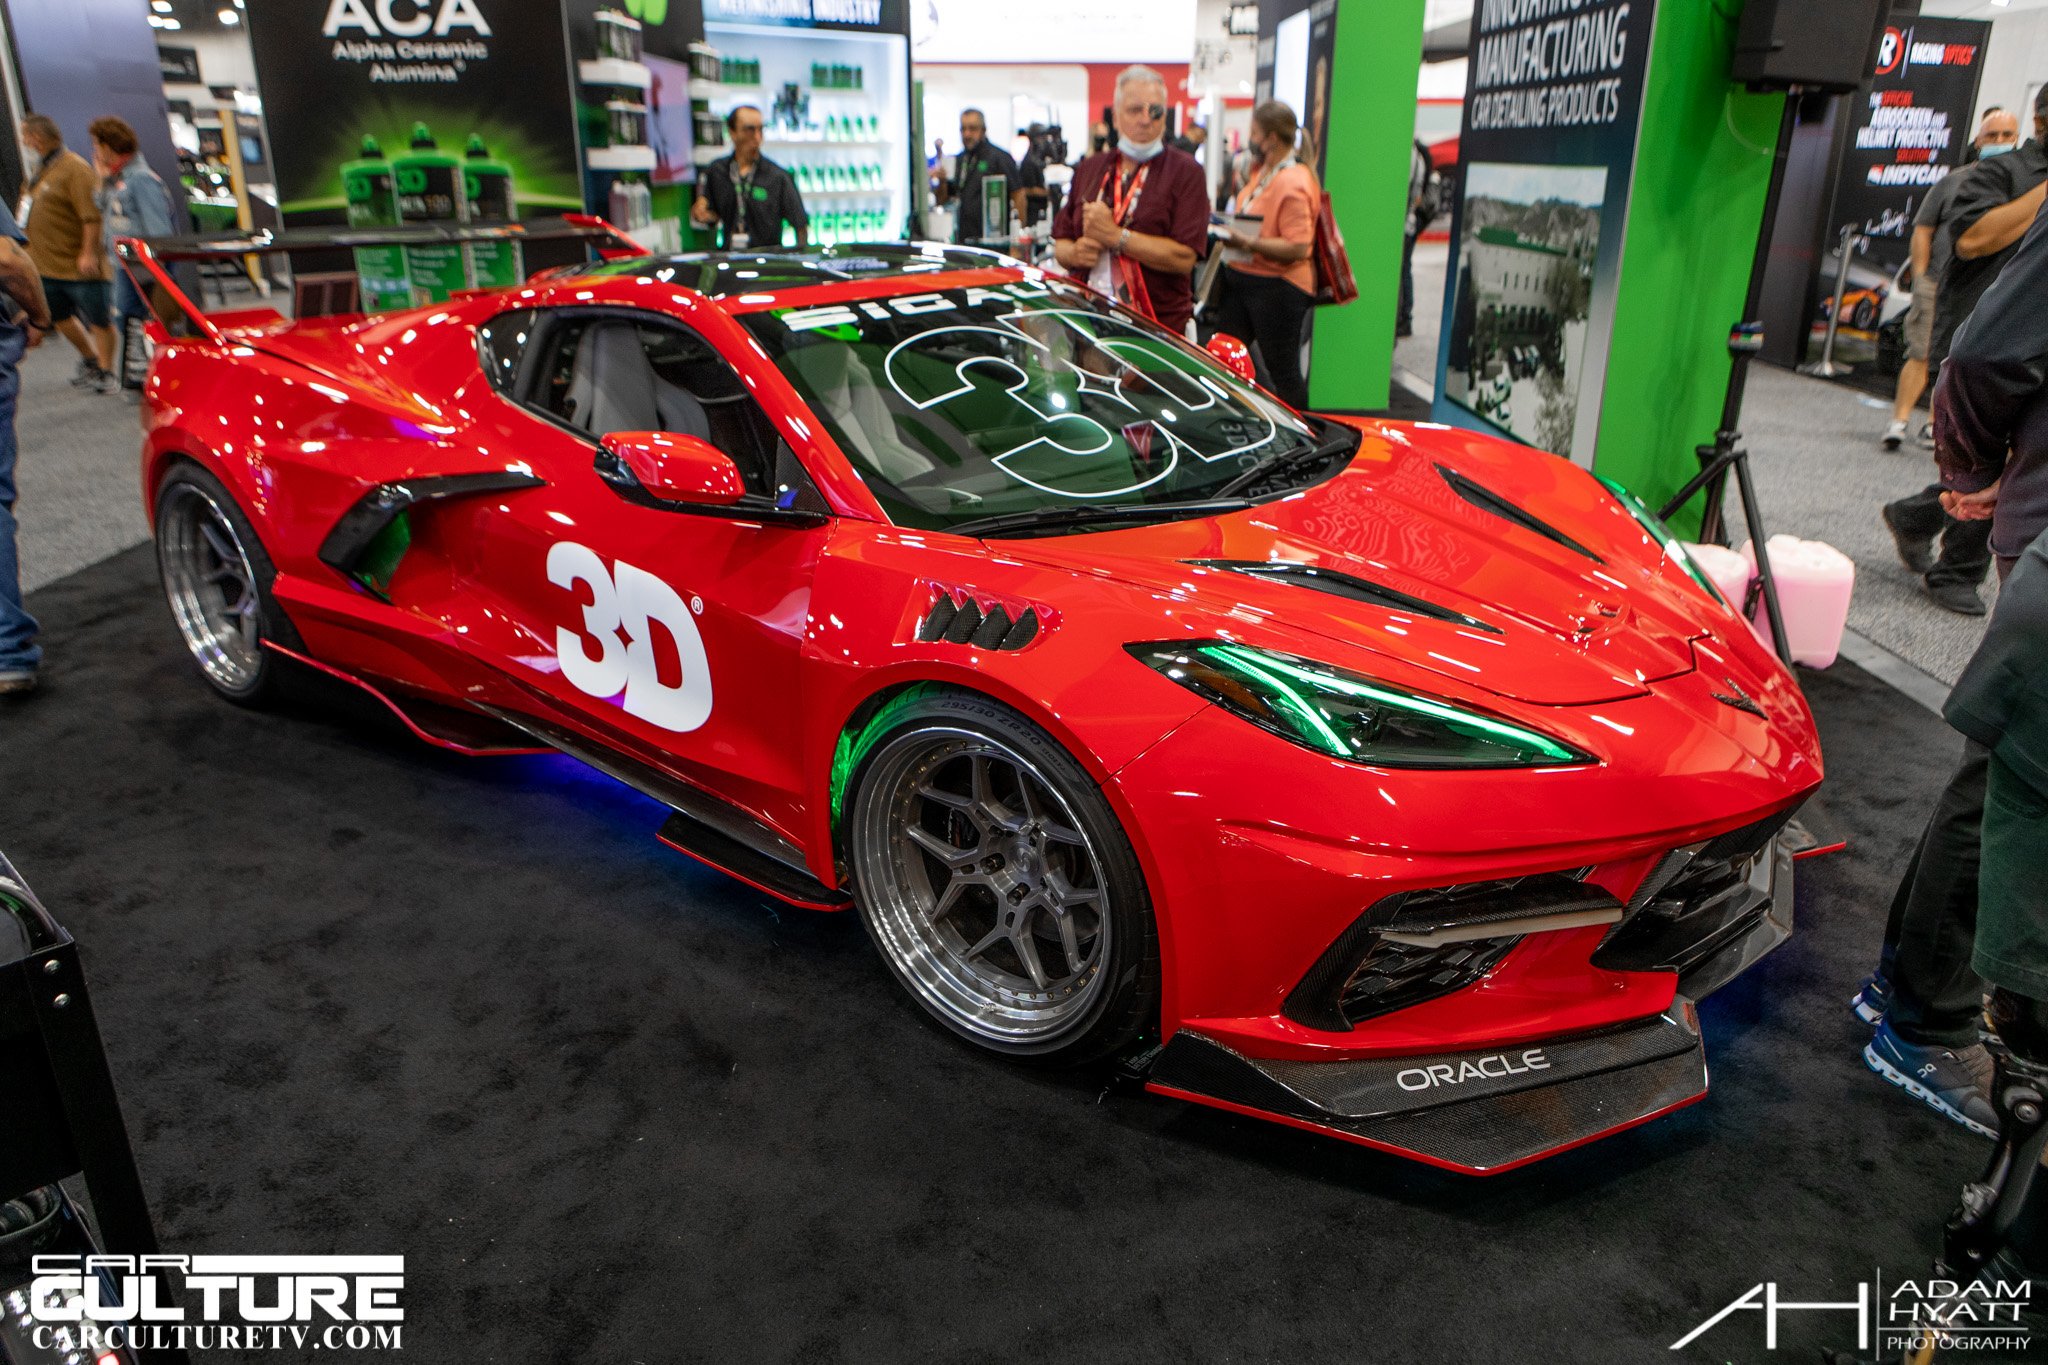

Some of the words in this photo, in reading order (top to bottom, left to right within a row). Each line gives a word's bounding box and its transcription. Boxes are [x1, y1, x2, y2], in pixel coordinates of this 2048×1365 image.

[322, 0, 493, 37] ACA
[332, 40, 396, 63] Alpha
[396, 39, 489, 60] Ceramic
[1475, 3, 1630, 89] MANUFACTURING
[369, 62, 459, 83] Alumina
[1471, 91, 1491, 130] CAR
[1489, 85, 1549, 129] DETAILING
[1547, 76, 1621, 127] PRODUCTS
[546, 541, 713, 733] 3D
[941, 701, 995, 718] 295/30
[998, 717, 1042, 746] ZR20
[1396, 1048, 1551, 1091] ORACLE
